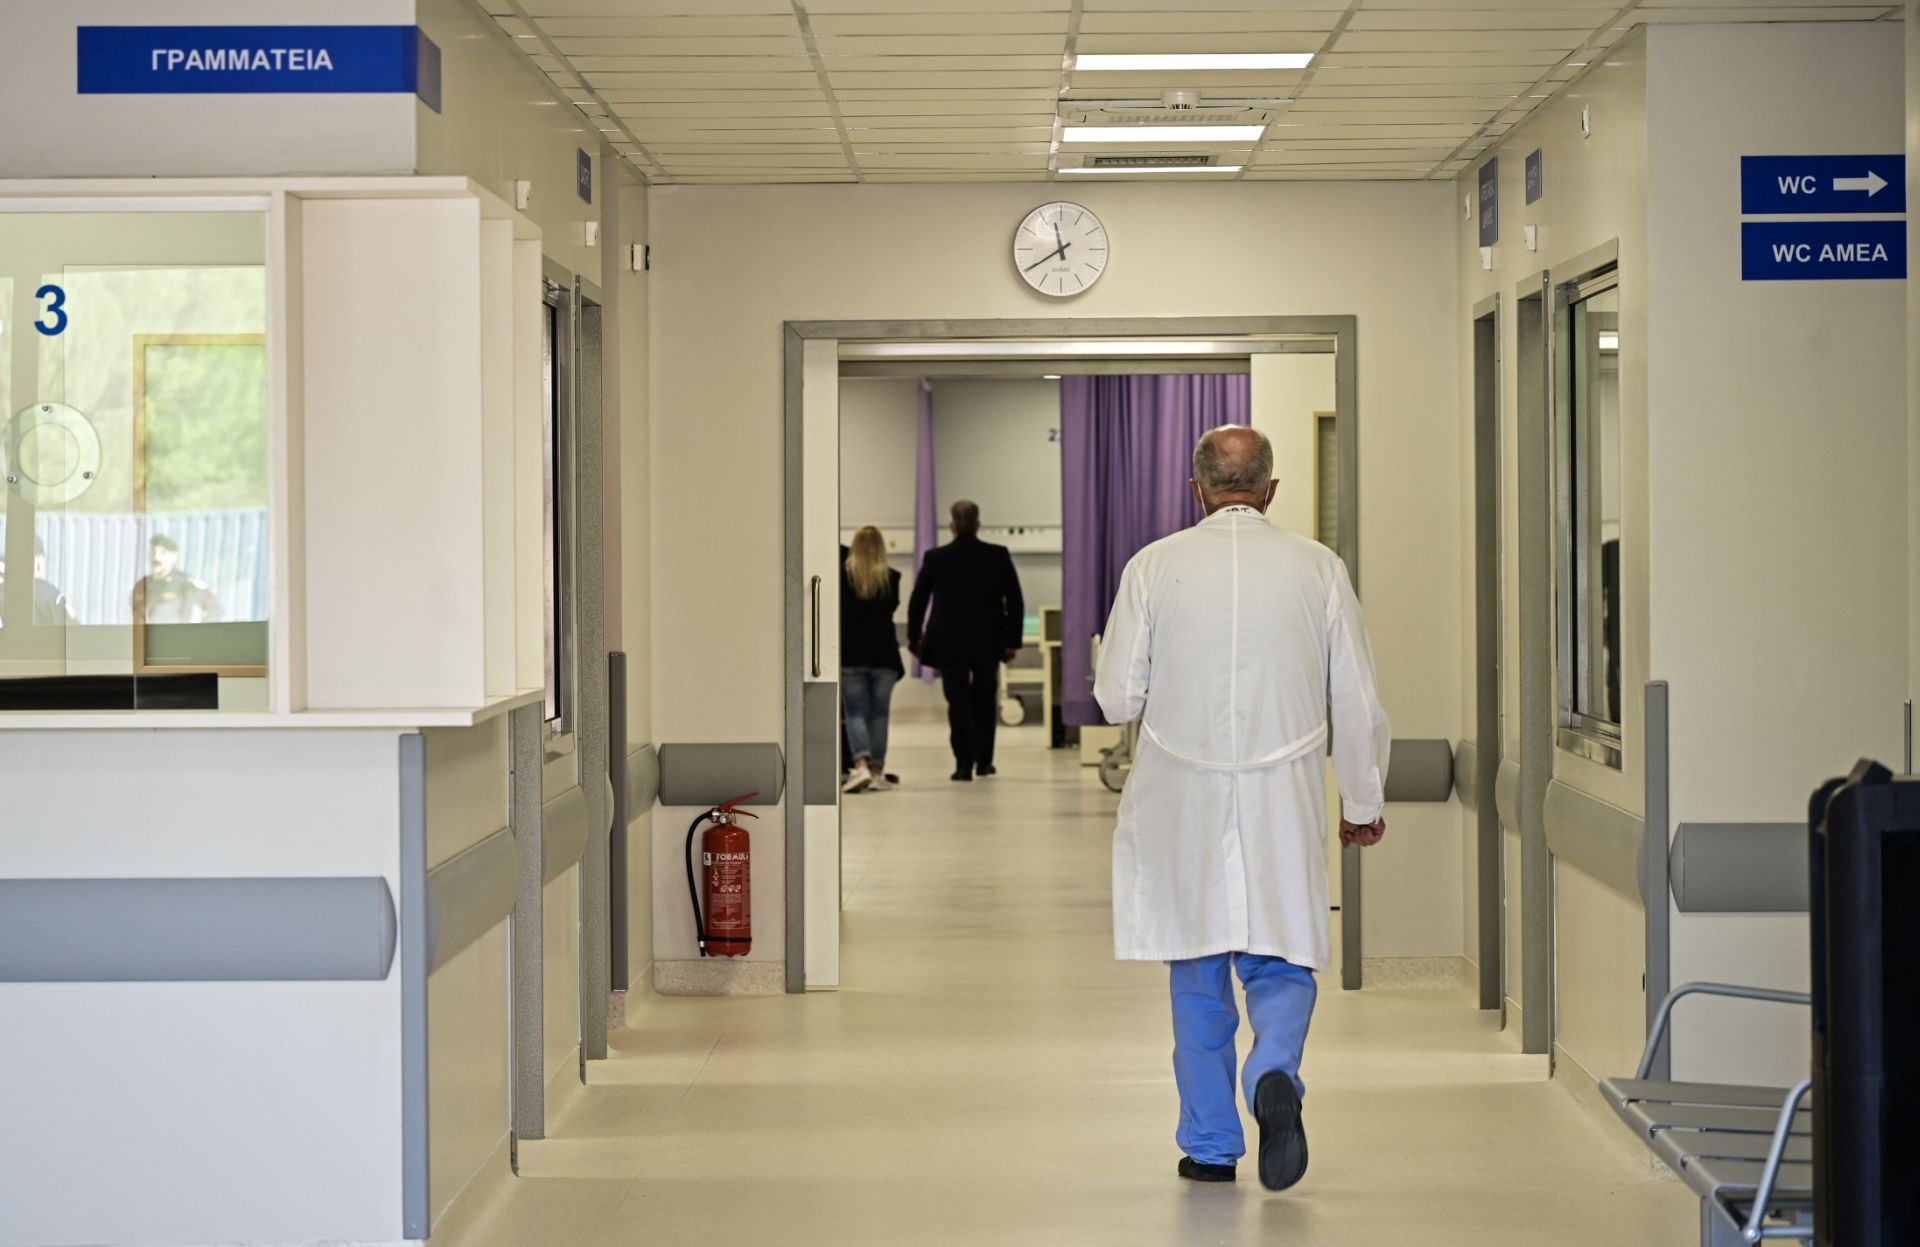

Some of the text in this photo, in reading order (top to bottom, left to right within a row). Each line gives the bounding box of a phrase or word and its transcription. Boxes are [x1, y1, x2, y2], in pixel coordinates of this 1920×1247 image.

[151, 48, 334, 71] ΓΡΑΜΜΑΤΕΙΑ
[1777, 176, 1817, 195] WC
[1772, 244, 1812, 263] WC
[34, 284, 68, 336] 3
